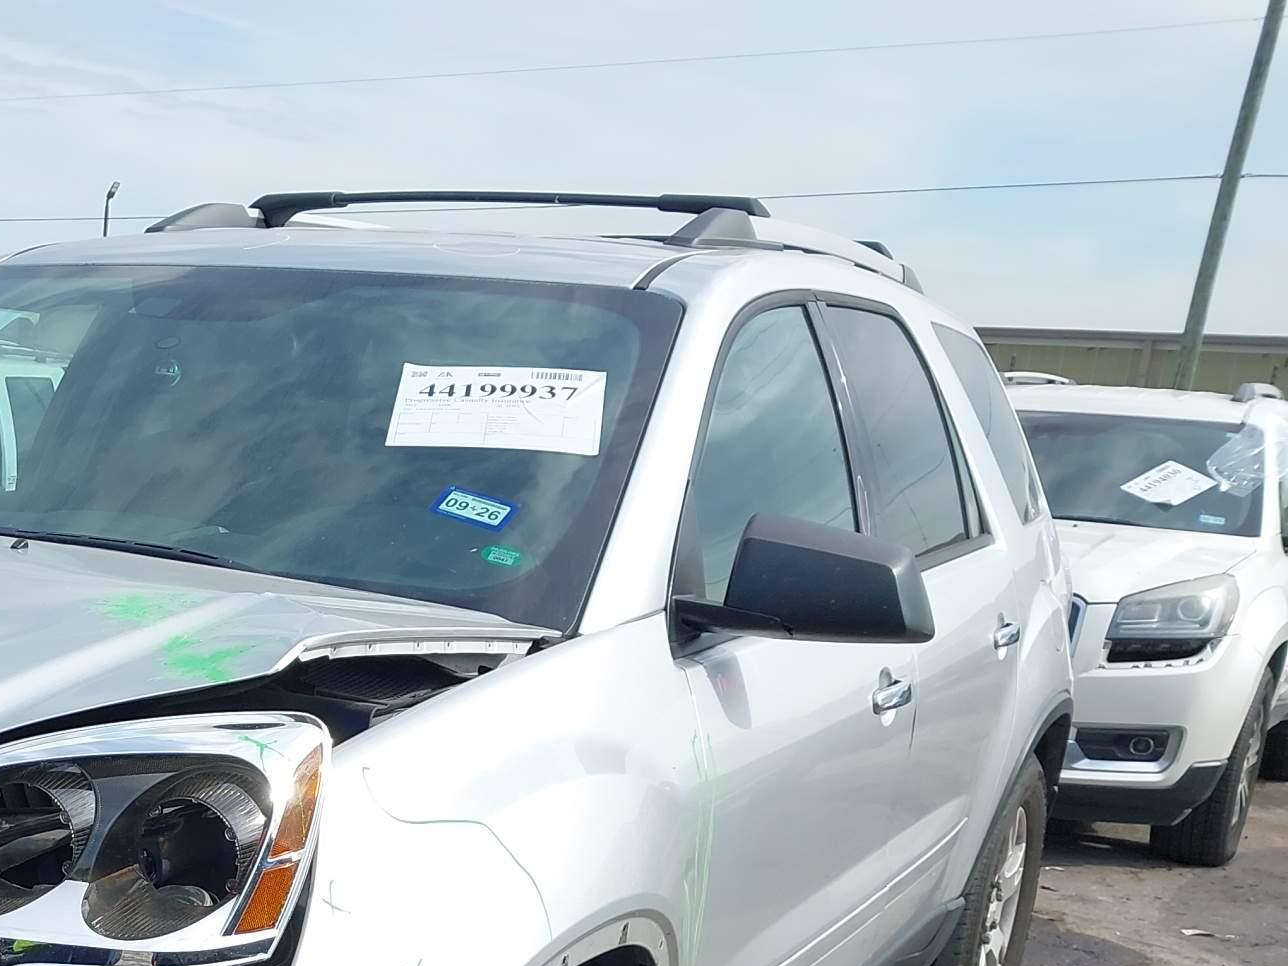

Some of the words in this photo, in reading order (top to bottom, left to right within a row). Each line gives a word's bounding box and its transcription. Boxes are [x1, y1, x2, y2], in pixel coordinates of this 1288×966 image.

[418, 383, 579, 401] 44199937
[445, 497, 470, 511] 09
[474, 506, 501, 521] 26
